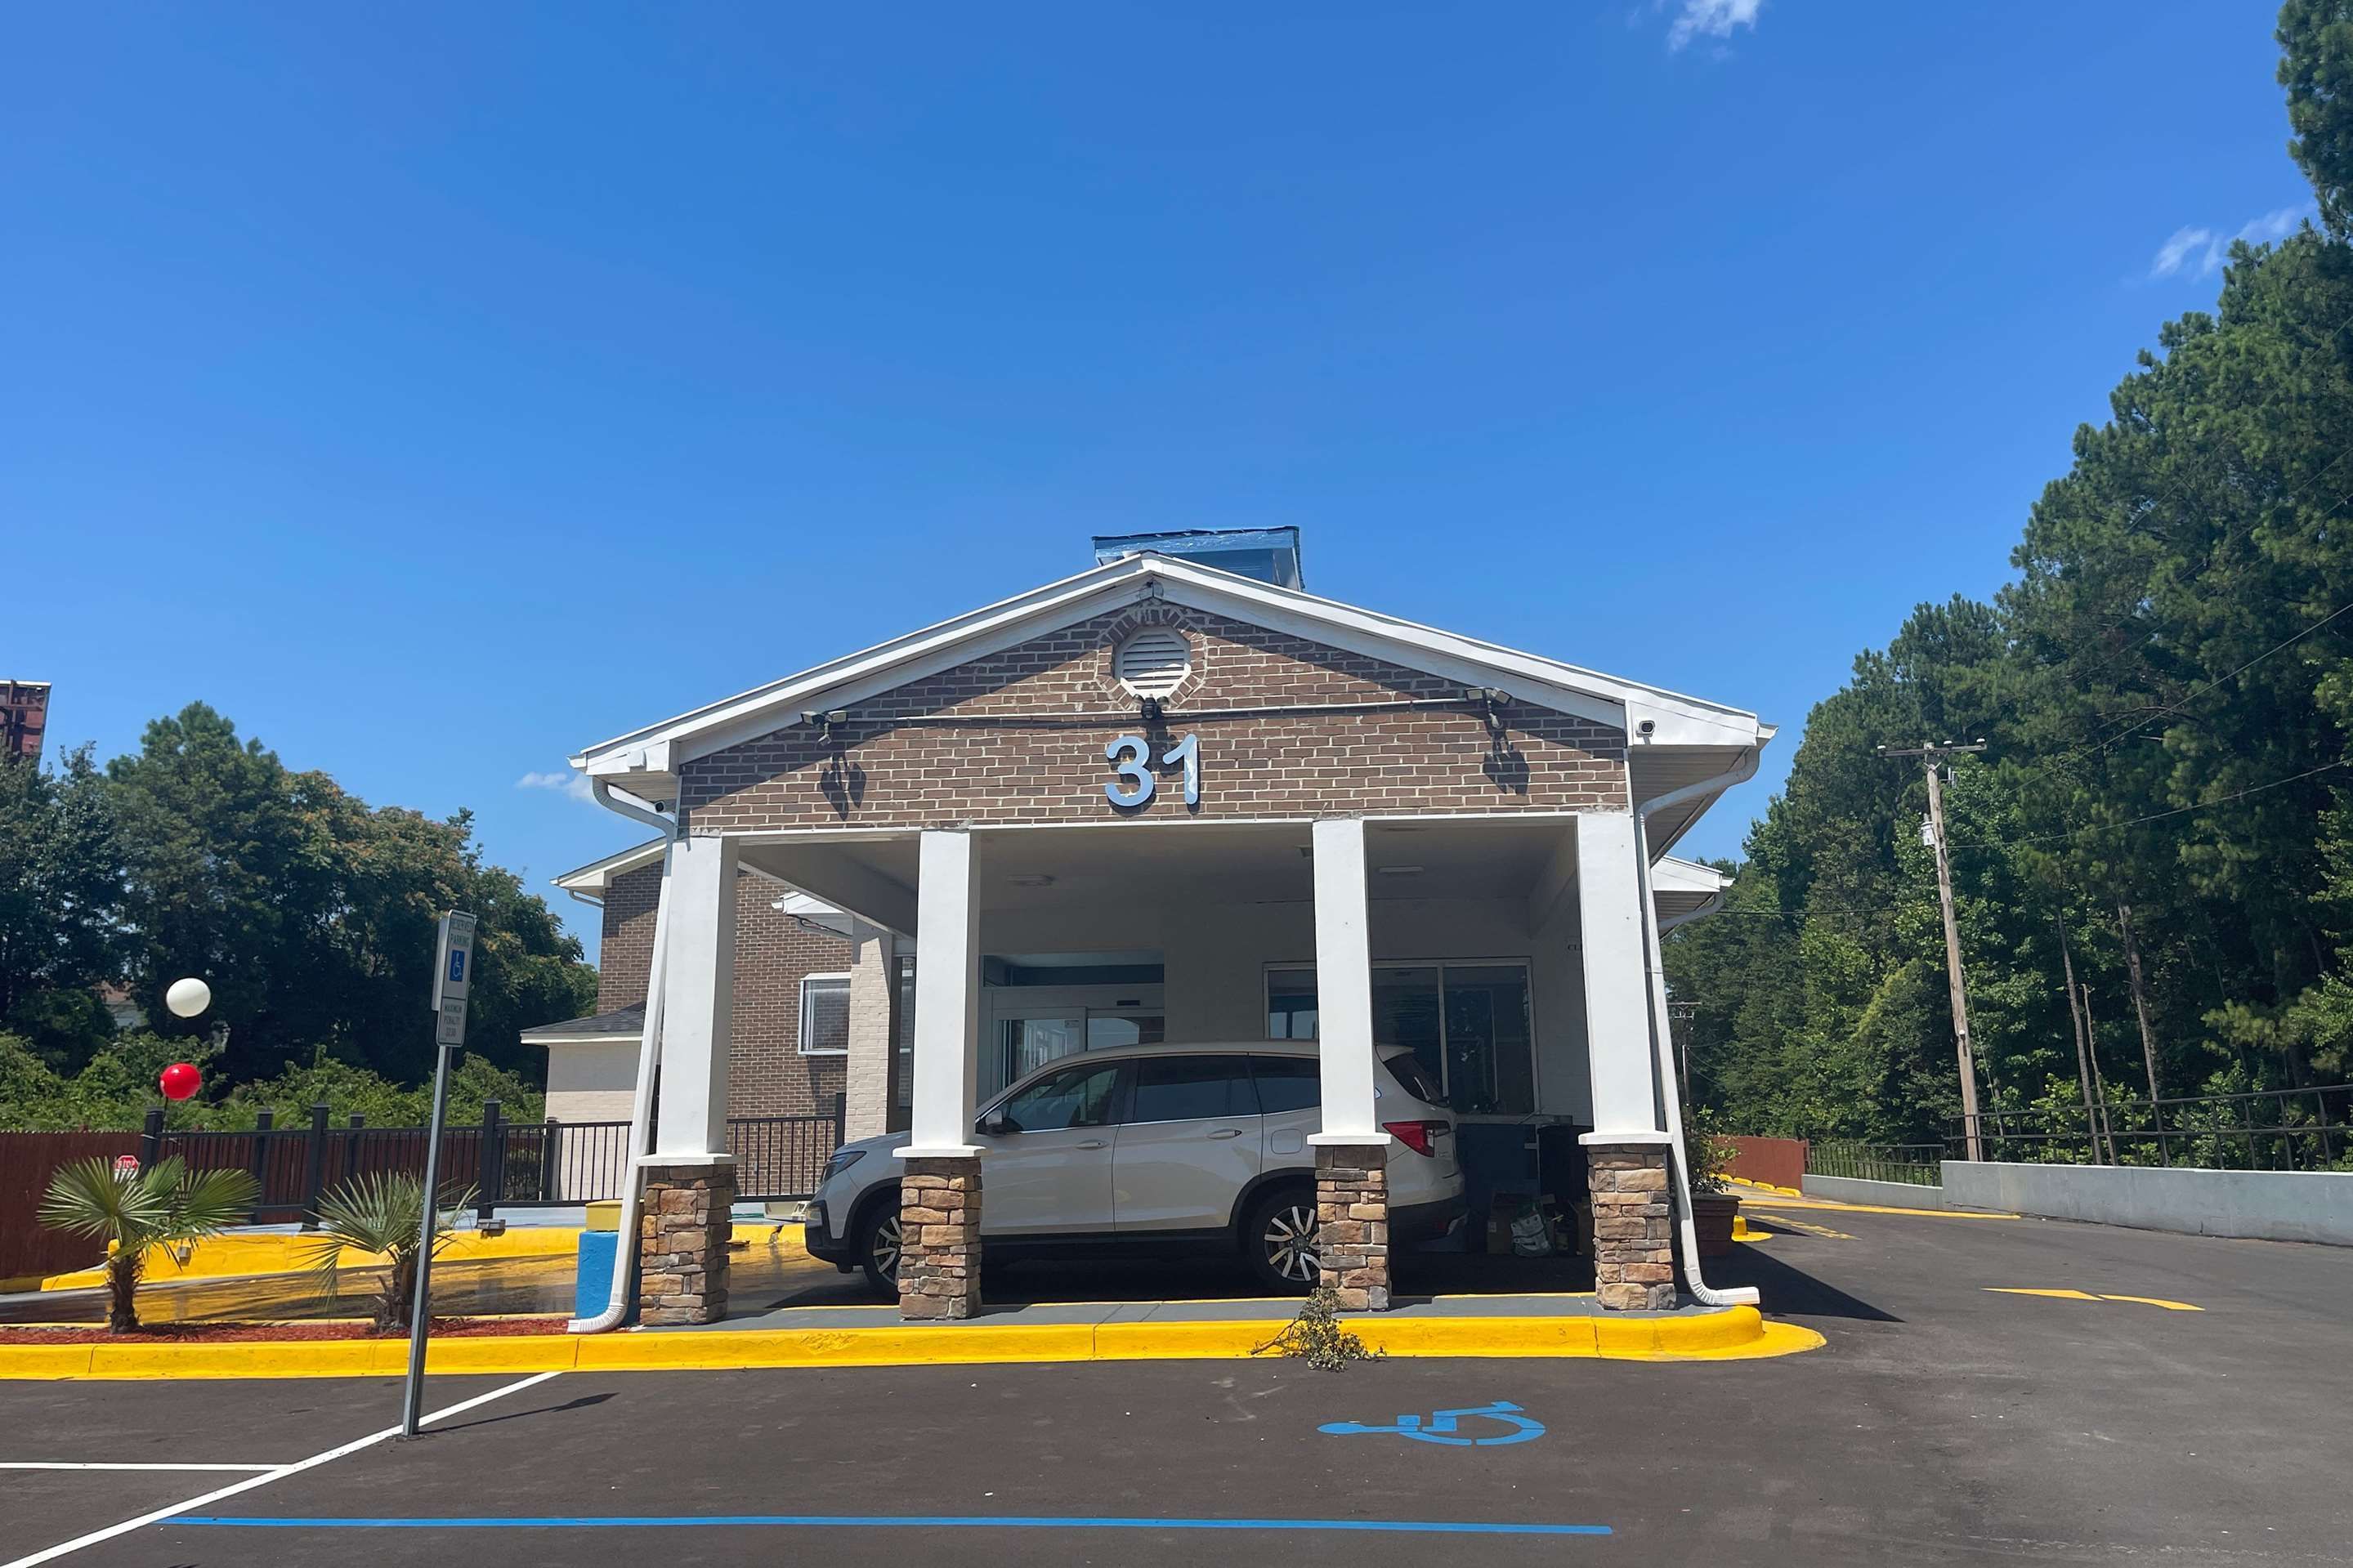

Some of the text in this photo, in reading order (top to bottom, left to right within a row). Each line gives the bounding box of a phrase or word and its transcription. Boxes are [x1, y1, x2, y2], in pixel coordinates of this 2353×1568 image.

[1105, 734, 1198, 806] 31
[450, 918, 472, 933] RESERVED
[450, 932, 471, 948] PARKING
[117, 1159, 136, 1169] STOP
